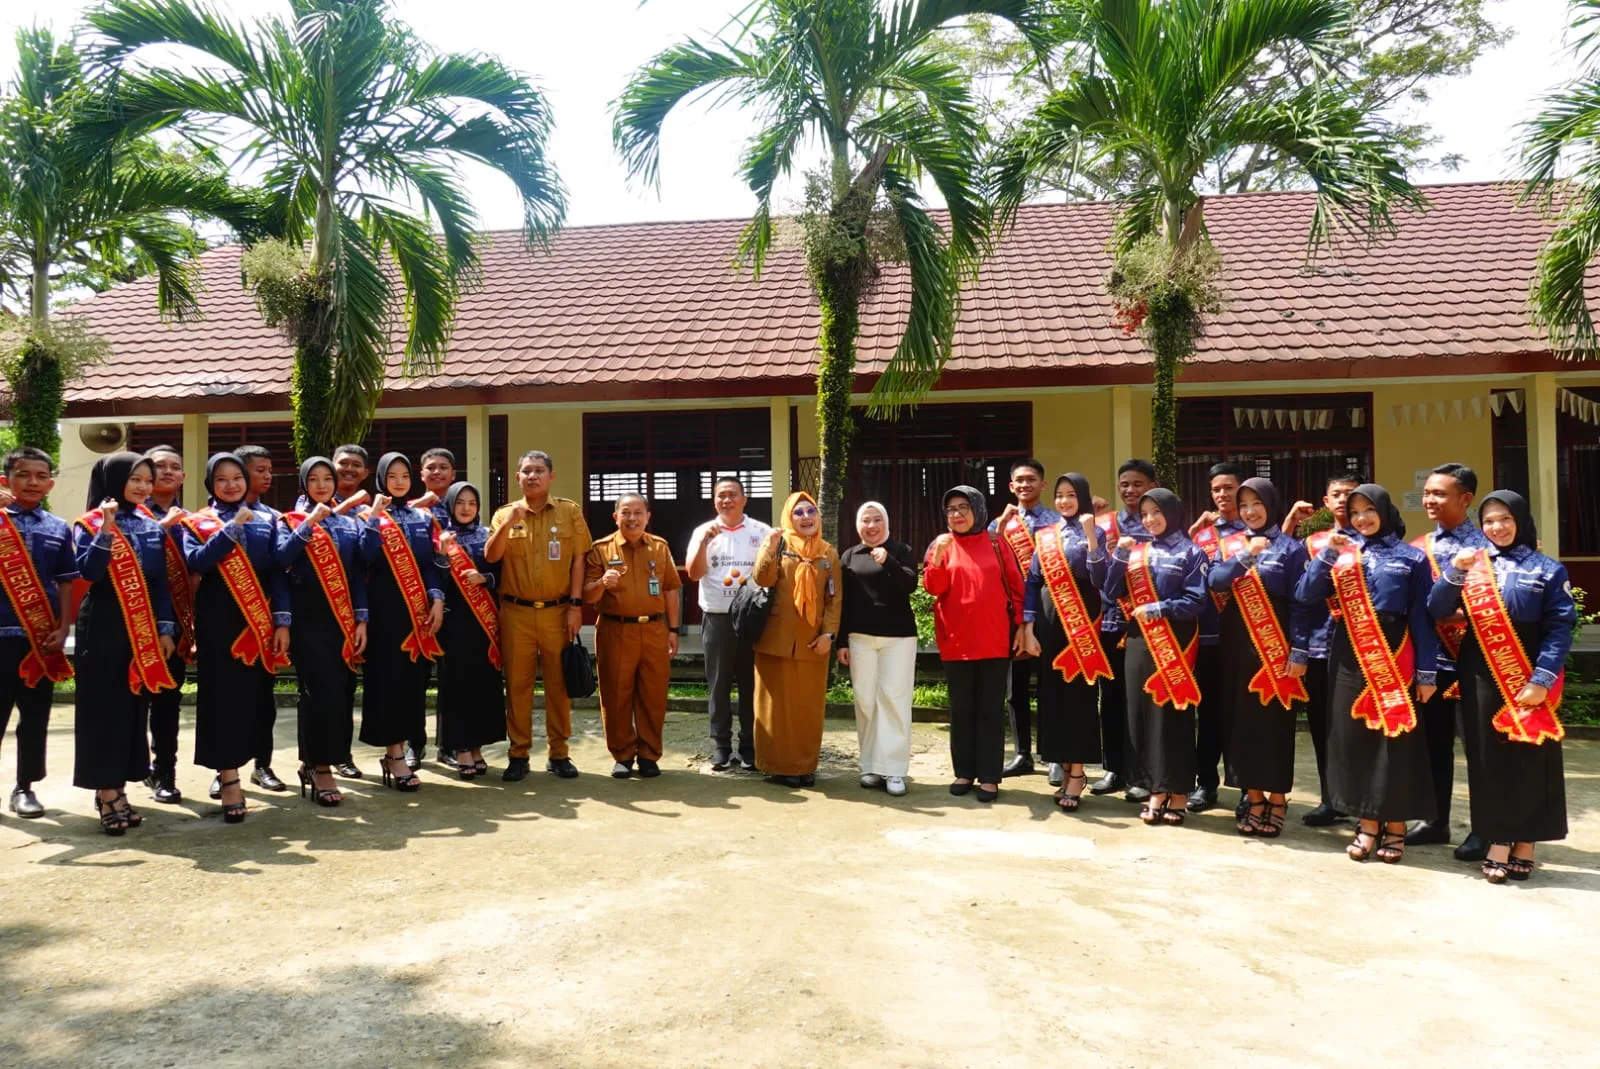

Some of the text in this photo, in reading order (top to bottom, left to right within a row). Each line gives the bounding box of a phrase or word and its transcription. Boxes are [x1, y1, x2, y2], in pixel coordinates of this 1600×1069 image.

[381, 525, 404, 553] GADIS
[3, 555, 40, 606] LITERASI
[115, 559, 144, 610] LITERASI
[1043, 540, 1096, 657] GADIS SMANPOEL 2026
[1336, 565, 1360, 599] GADIS
[1345, 596, 1378, 650] BERBAKAT
[1473, 604, 1506, 647] PIK-R
